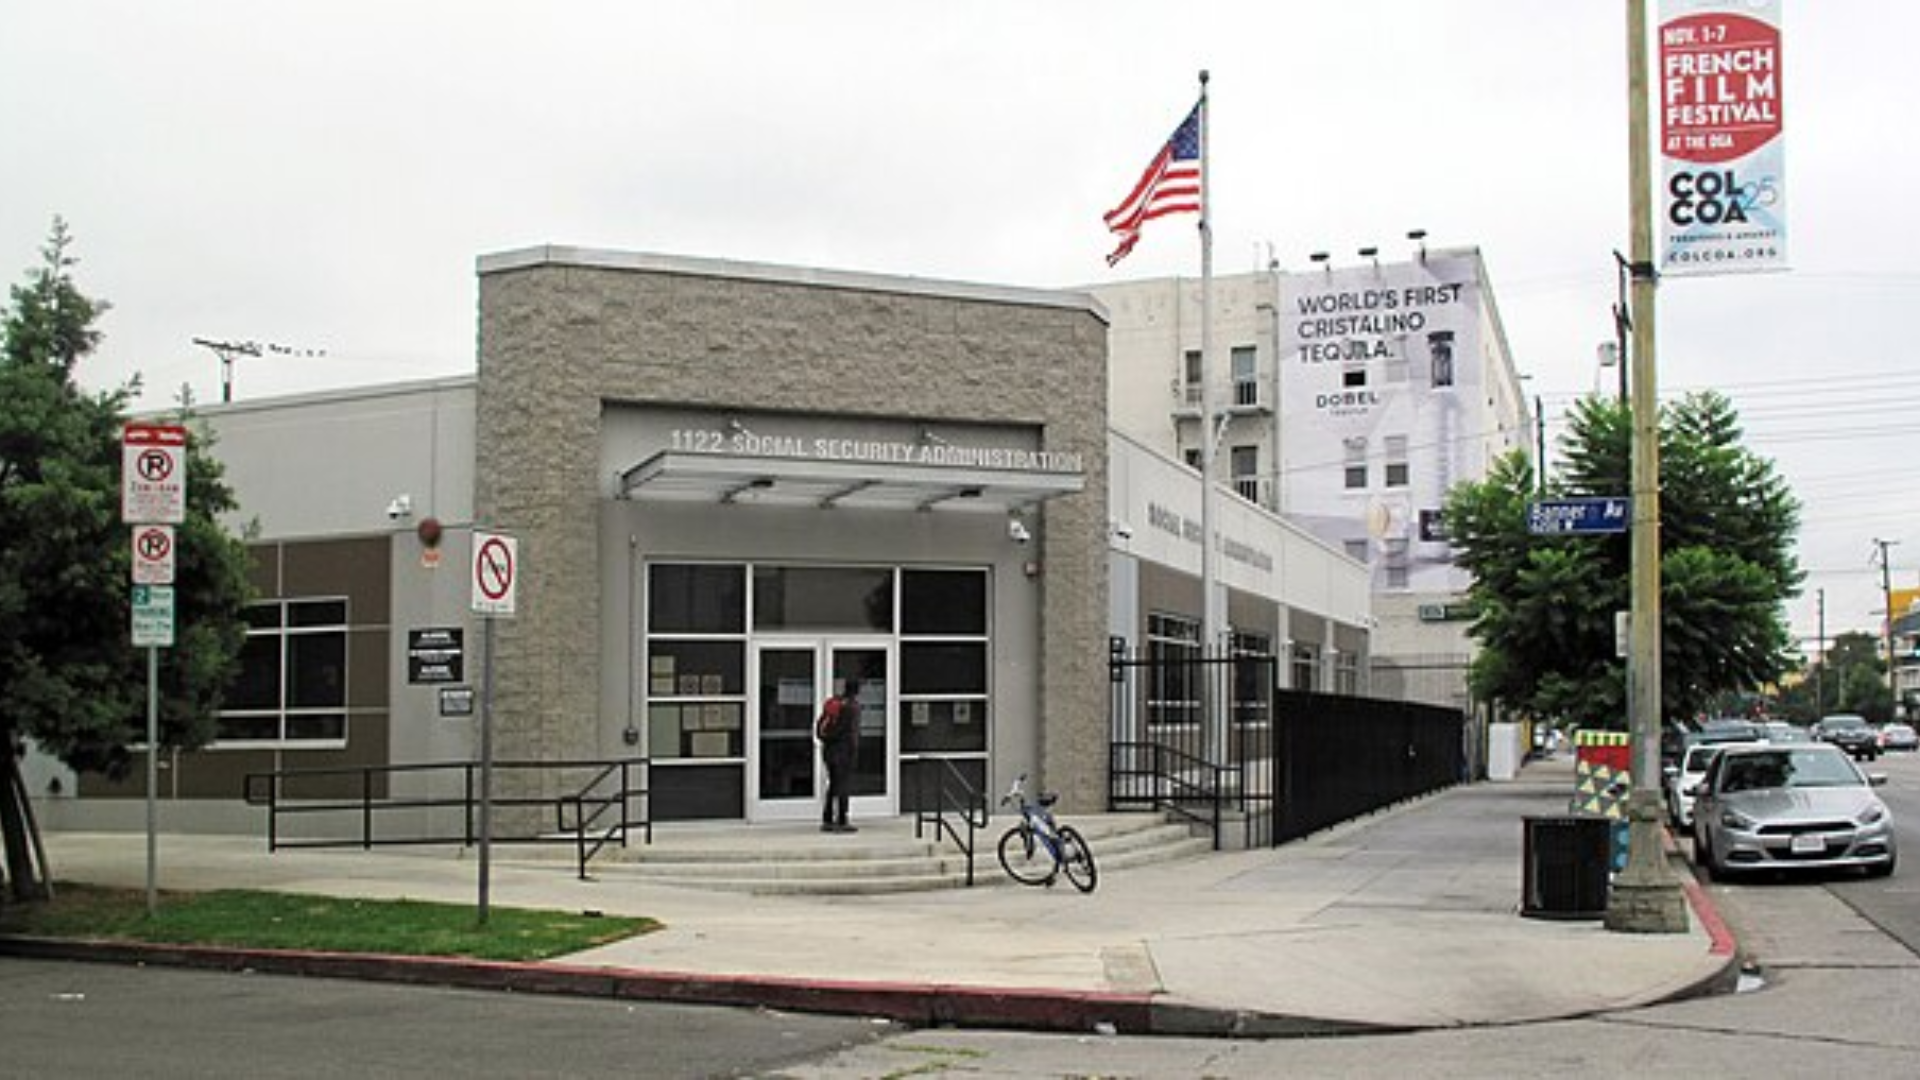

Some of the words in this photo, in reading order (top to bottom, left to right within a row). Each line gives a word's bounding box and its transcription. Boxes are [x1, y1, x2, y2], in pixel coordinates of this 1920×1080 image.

[1666, 48, 1774, 76] FRENCH
[1666, 73, 1776, 103] FILM
[1667, 102, 1776, 125] FESTIVAL
[1669, 170, 1744, 198] COL
[1669, 199, 1748, 226] COA
[1669, 248, 1777, 261] COLCOA.ORG
[1297, 289, 1398, 314] WORLD'S
[1404, 282, 1463, 307] FIRST
[1297, 311, 1426, 338] CRISTALINO
[672, 429, 723, 453] 1122
[732, 432, 808, 457] SOCIAL
[814, 438, 913, 464] SECURITY
[921, 444, 1083, 473] ADMINISTRATION
